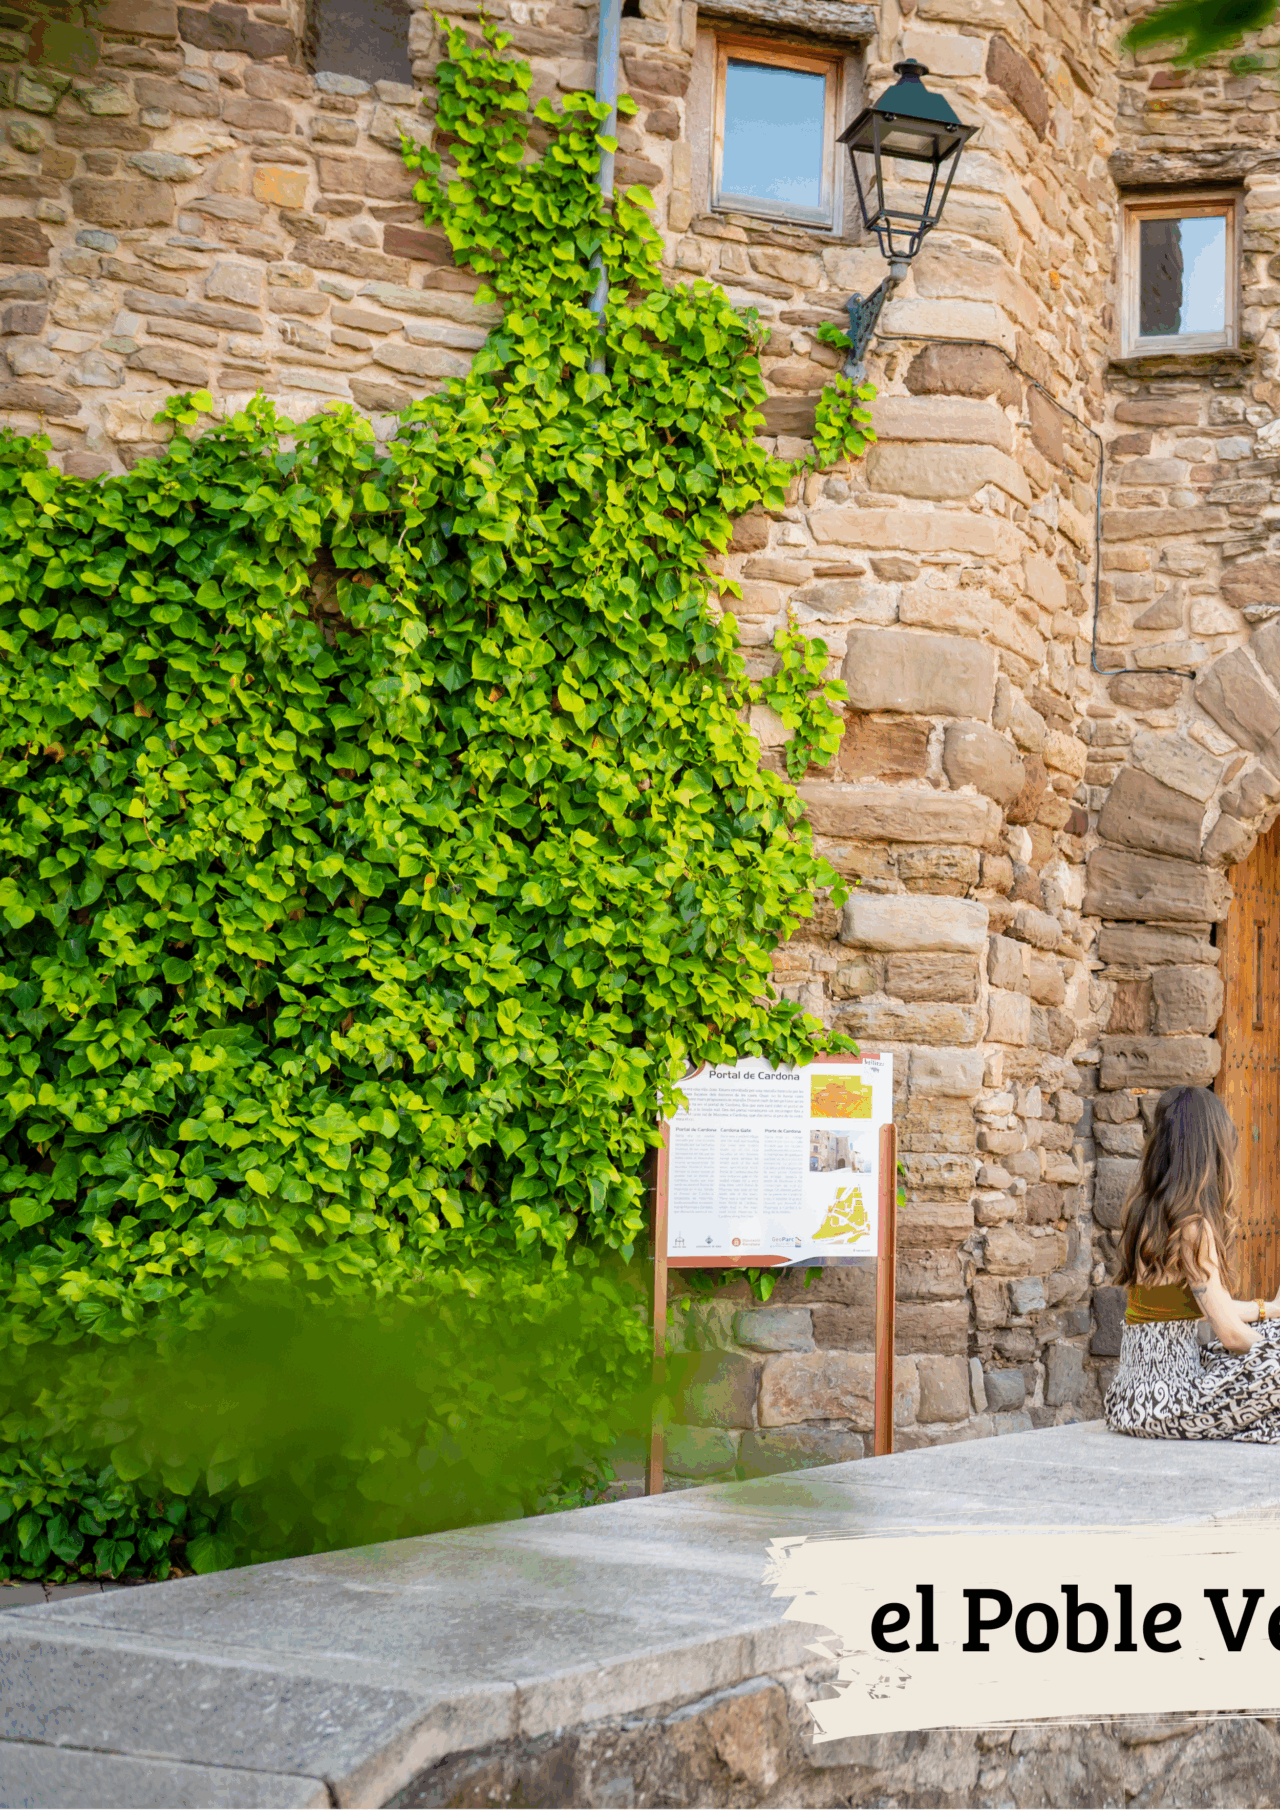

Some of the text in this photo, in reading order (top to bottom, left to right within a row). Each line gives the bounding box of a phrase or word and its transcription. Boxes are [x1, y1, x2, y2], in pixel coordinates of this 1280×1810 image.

[709, 1070, 801, 1081] Portal de Cardona
